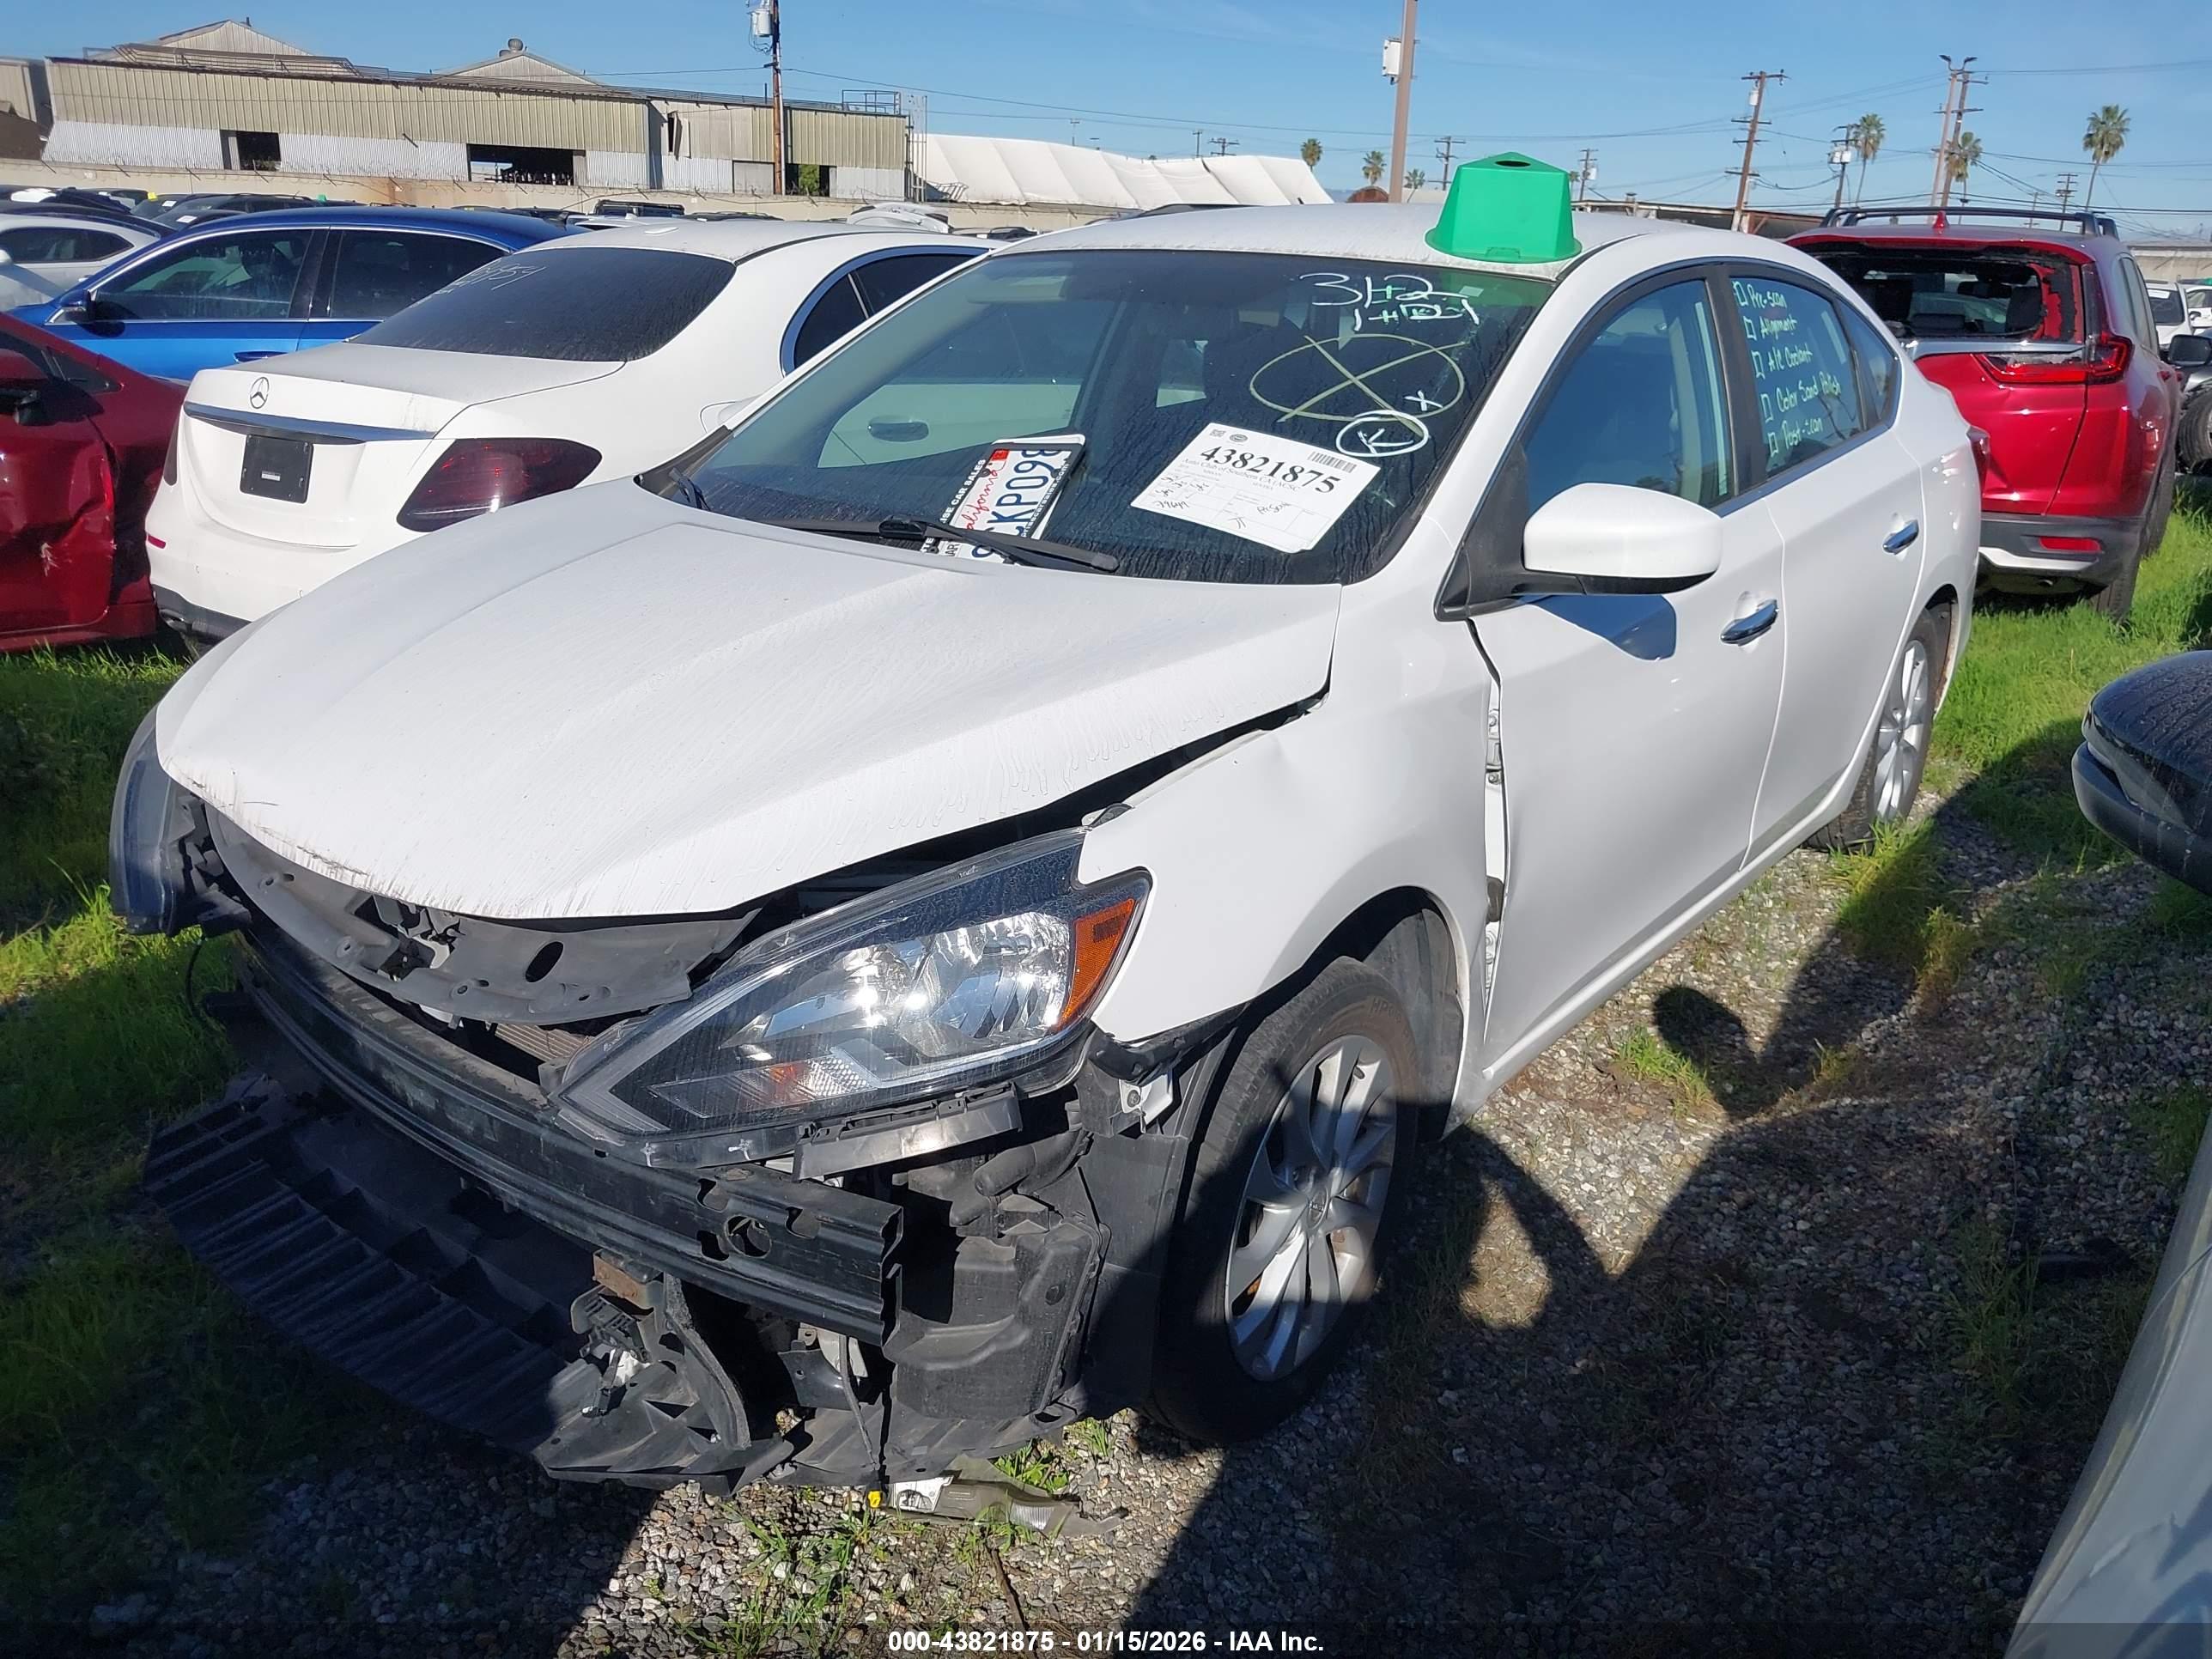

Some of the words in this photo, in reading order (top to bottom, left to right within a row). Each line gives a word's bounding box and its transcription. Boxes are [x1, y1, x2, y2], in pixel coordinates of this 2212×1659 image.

[951, 487, 968, 507] CAR
[963, 459, 987, 486] SALES
[1200, 445, 1343, 494] 43821875
[962, 461, 1005, 530] alifornia
